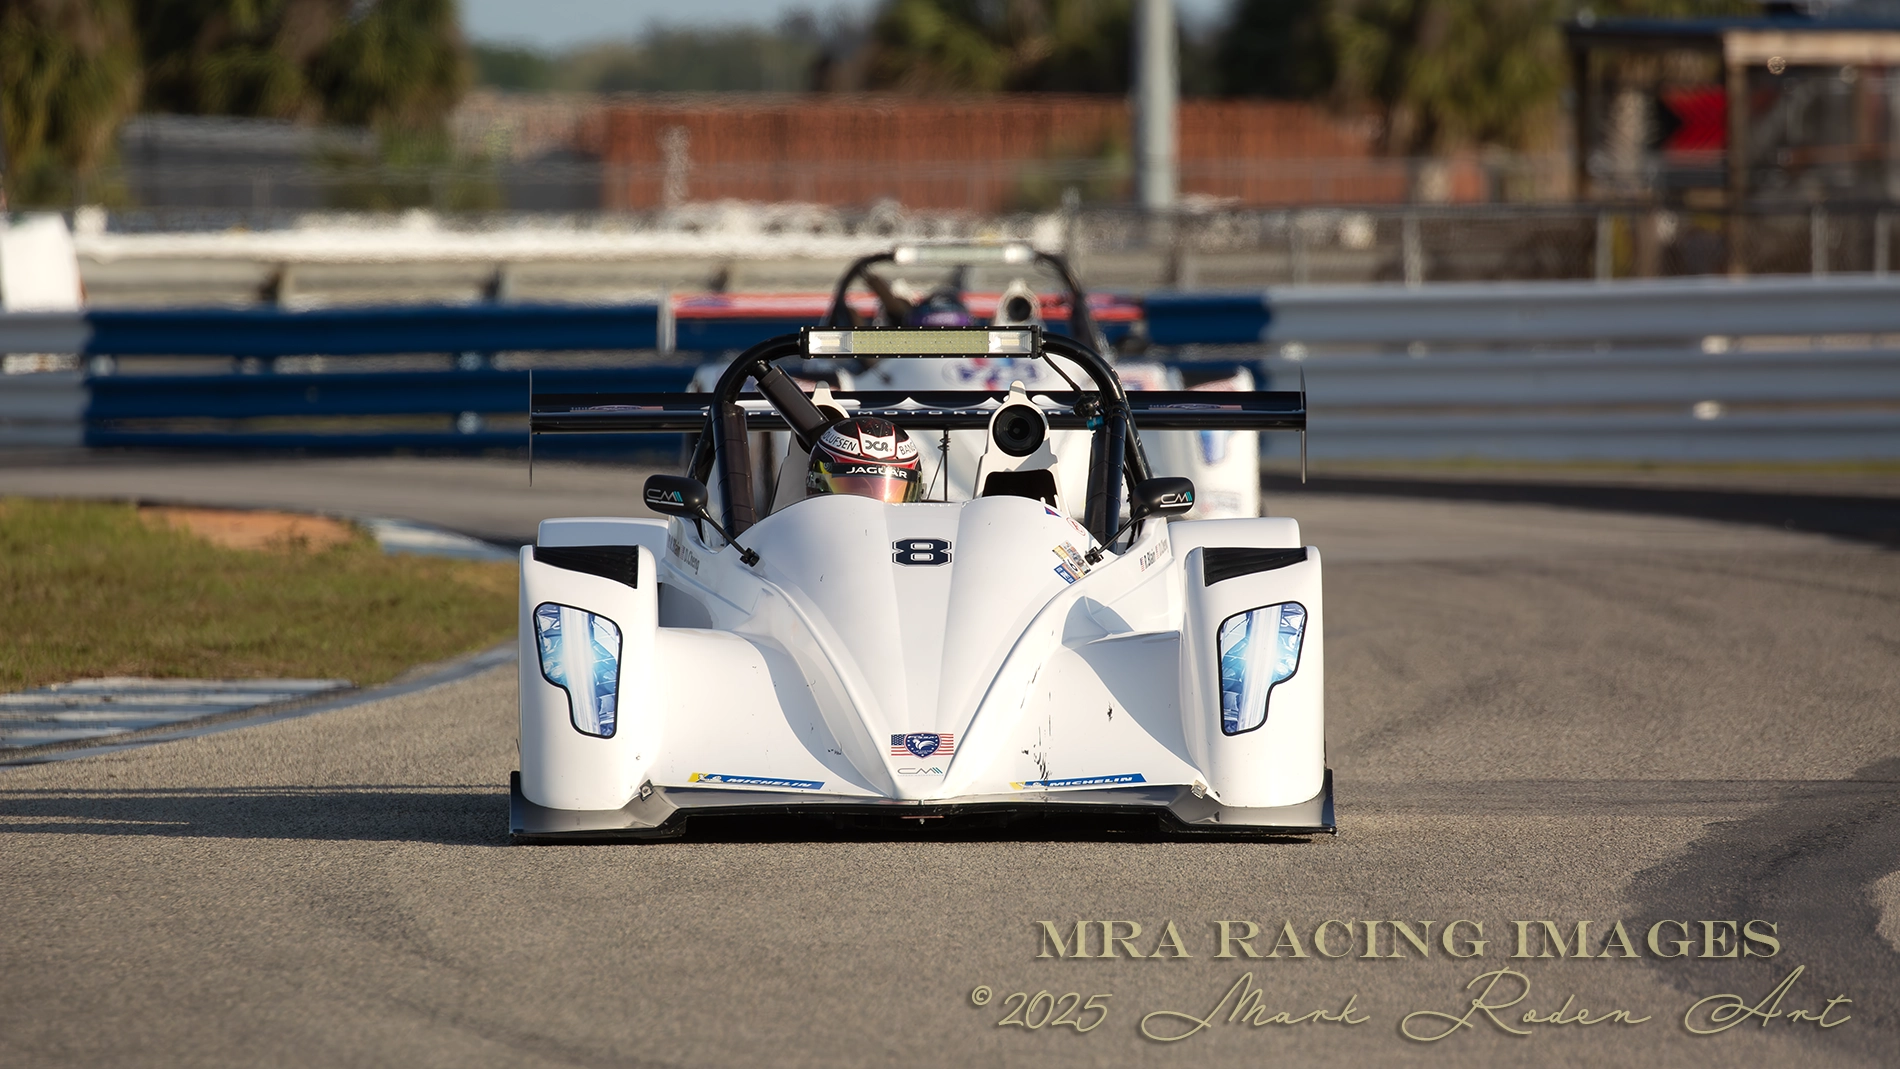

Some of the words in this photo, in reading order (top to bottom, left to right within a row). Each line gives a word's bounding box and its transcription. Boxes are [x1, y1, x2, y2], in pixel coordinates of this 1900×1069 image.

[846, 465, 908, 479] JAGUAR
[891, 537, 952, 567] 8
[725, 777, 813, 788] MICHELIN
[1049, 776, 1133, 788] MICHELIN
